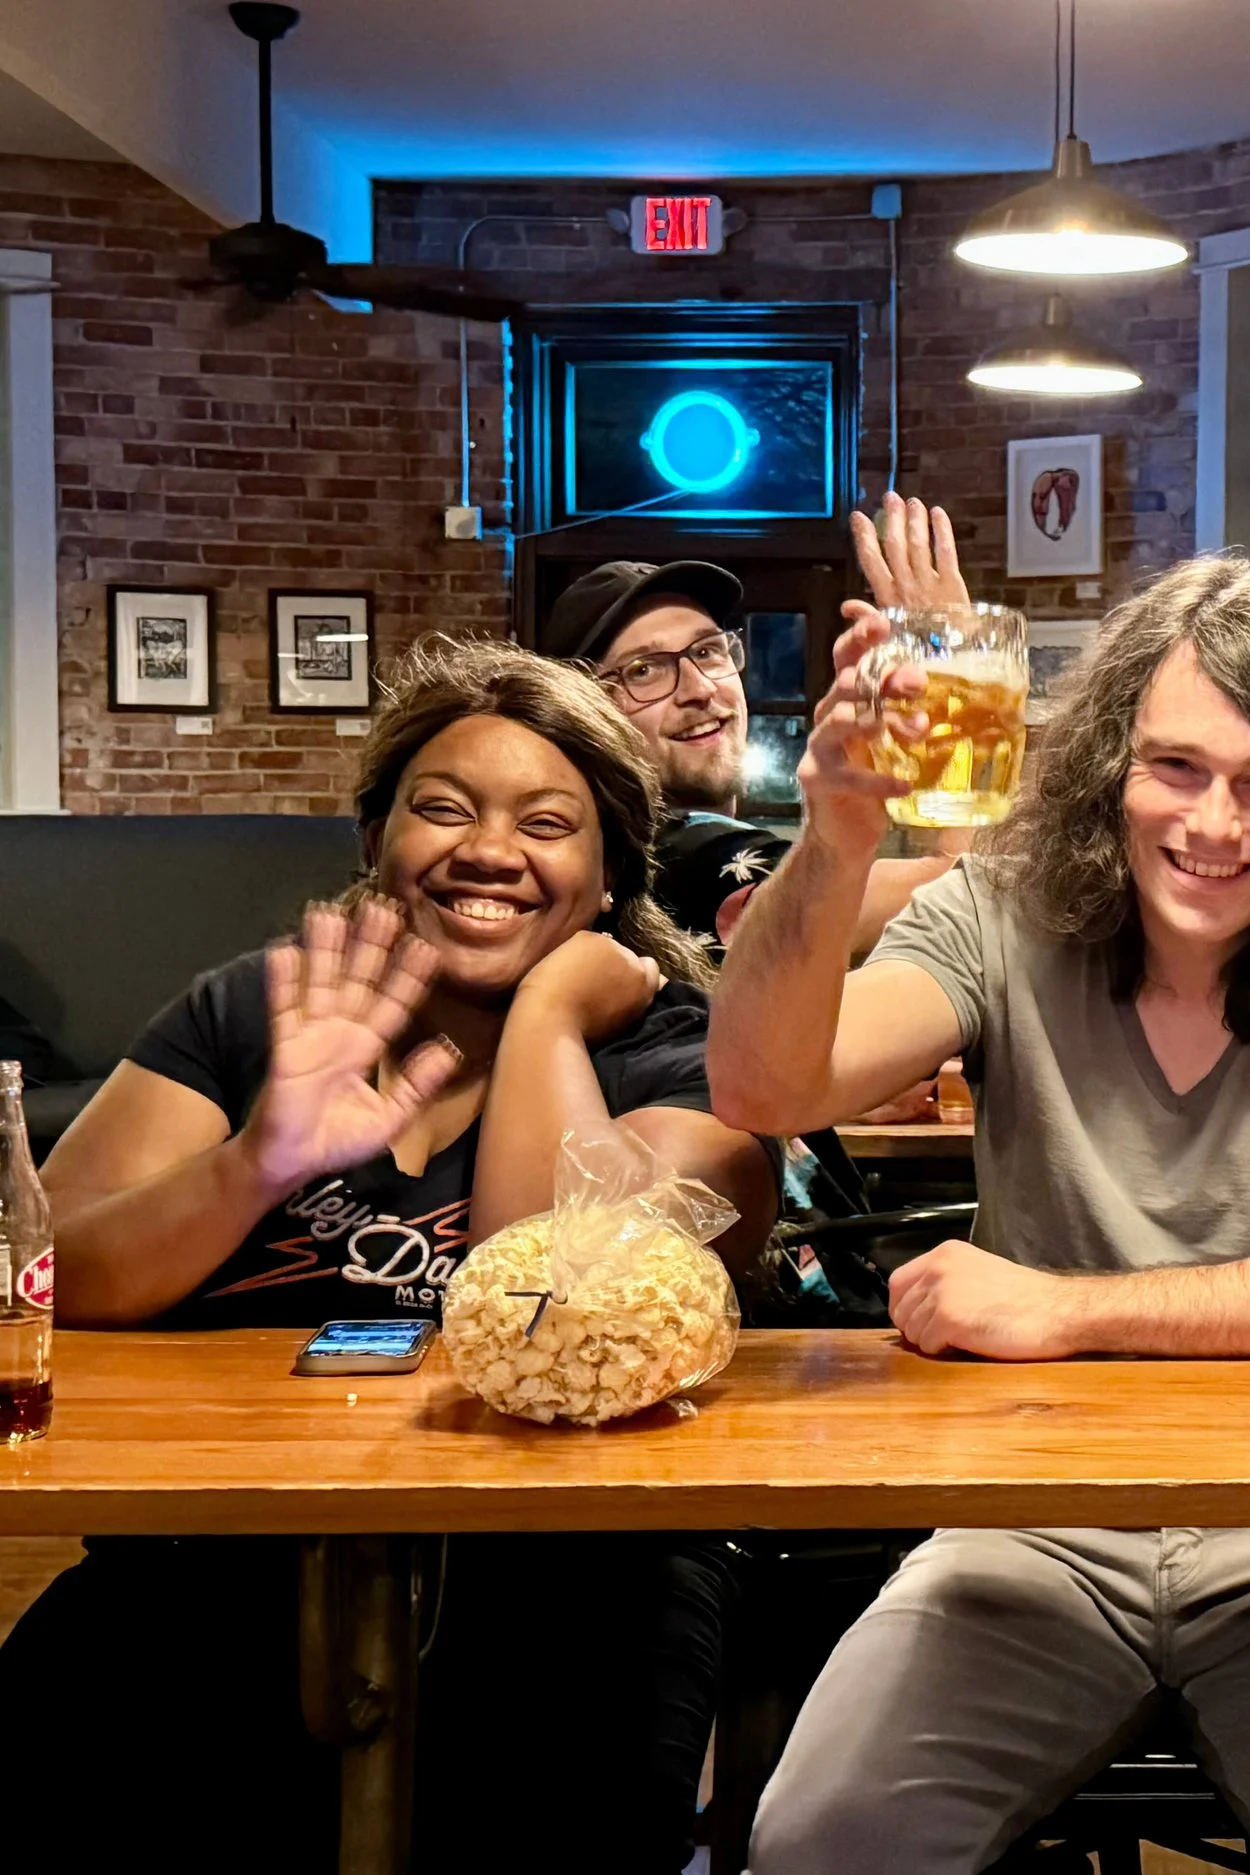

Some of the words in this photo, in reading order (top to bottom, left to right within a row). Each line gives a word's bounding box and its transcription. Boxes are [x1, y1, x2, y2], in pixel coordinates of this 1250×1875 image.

[646, 197, 711, 250] EXIT
[342, 1223, 457, 1286] Da
[395, 1285, 445, 1303] MOT
